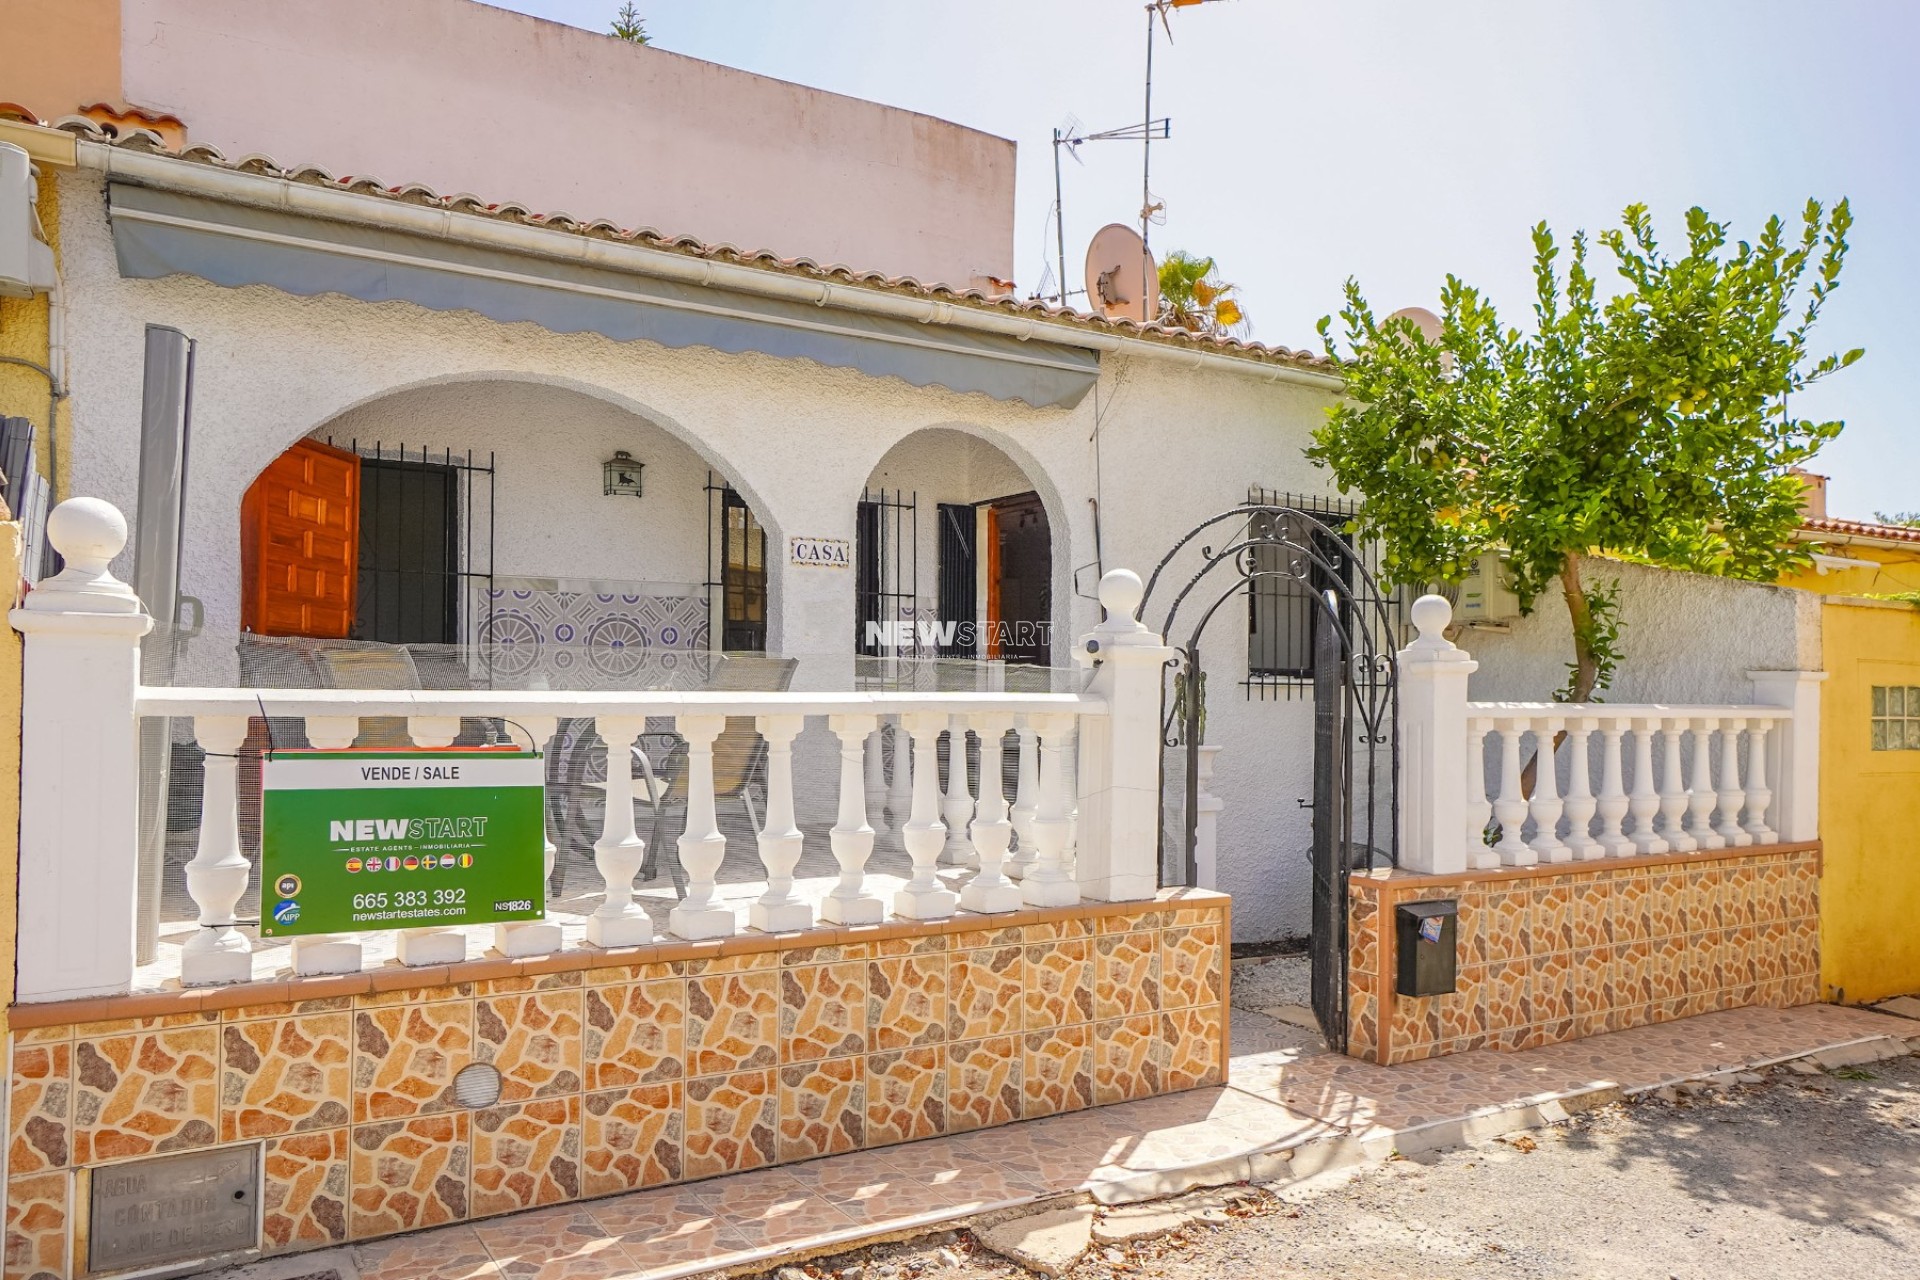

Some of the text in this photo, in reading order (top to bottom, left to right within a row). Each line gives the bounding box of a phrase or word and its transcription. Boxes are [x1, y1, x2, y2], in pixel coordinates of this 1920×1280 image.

[796, 543, 845, 562] CASA
[361, 766, 411, 781] VENDE
[423, 766, 460, 780] SALE
[329, 816, 488, 842] NEWSTART
[382, 844, 413, 852] AGENTS
[419, 843, 471, 851] INMOBILIARIA
[352, 888, 466, 910] 665 383 392
[281, 912, 300, 922] AIPP
[352, 907, 467, 922] newstartestates.com
[104, 1174, 147, 1199] AGUA
